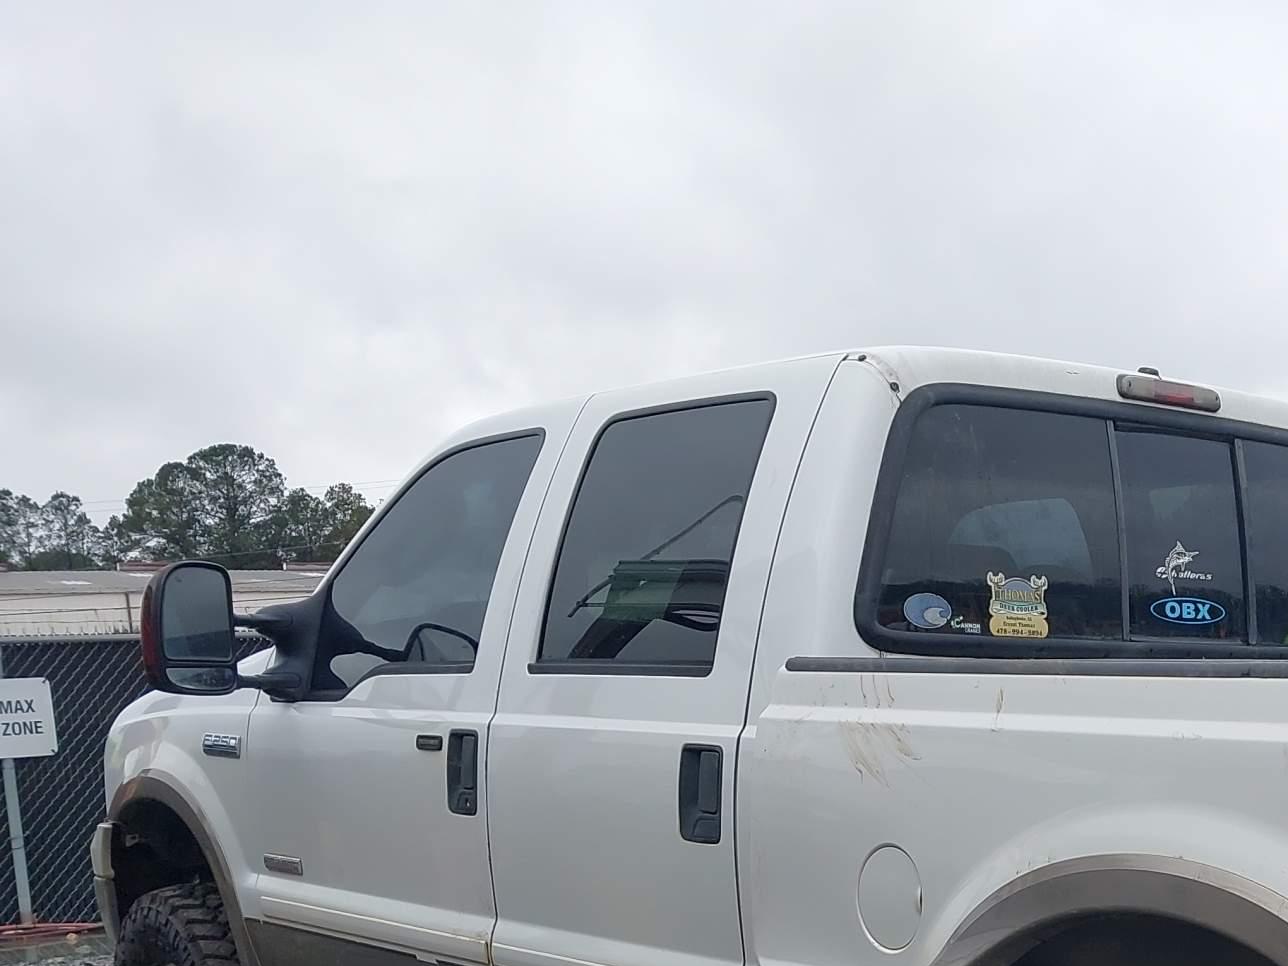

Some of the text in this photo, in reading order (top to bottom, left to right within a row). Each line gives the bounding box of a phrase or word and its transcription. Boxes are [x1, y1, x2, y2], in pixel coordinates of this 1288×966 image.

[997, 588, 1041, 603] THOMAS
[1165, 601, 1212, 620] OBX
[0, 699, 36, 714] MAX
[1, 720, 44, 736] ZONE
